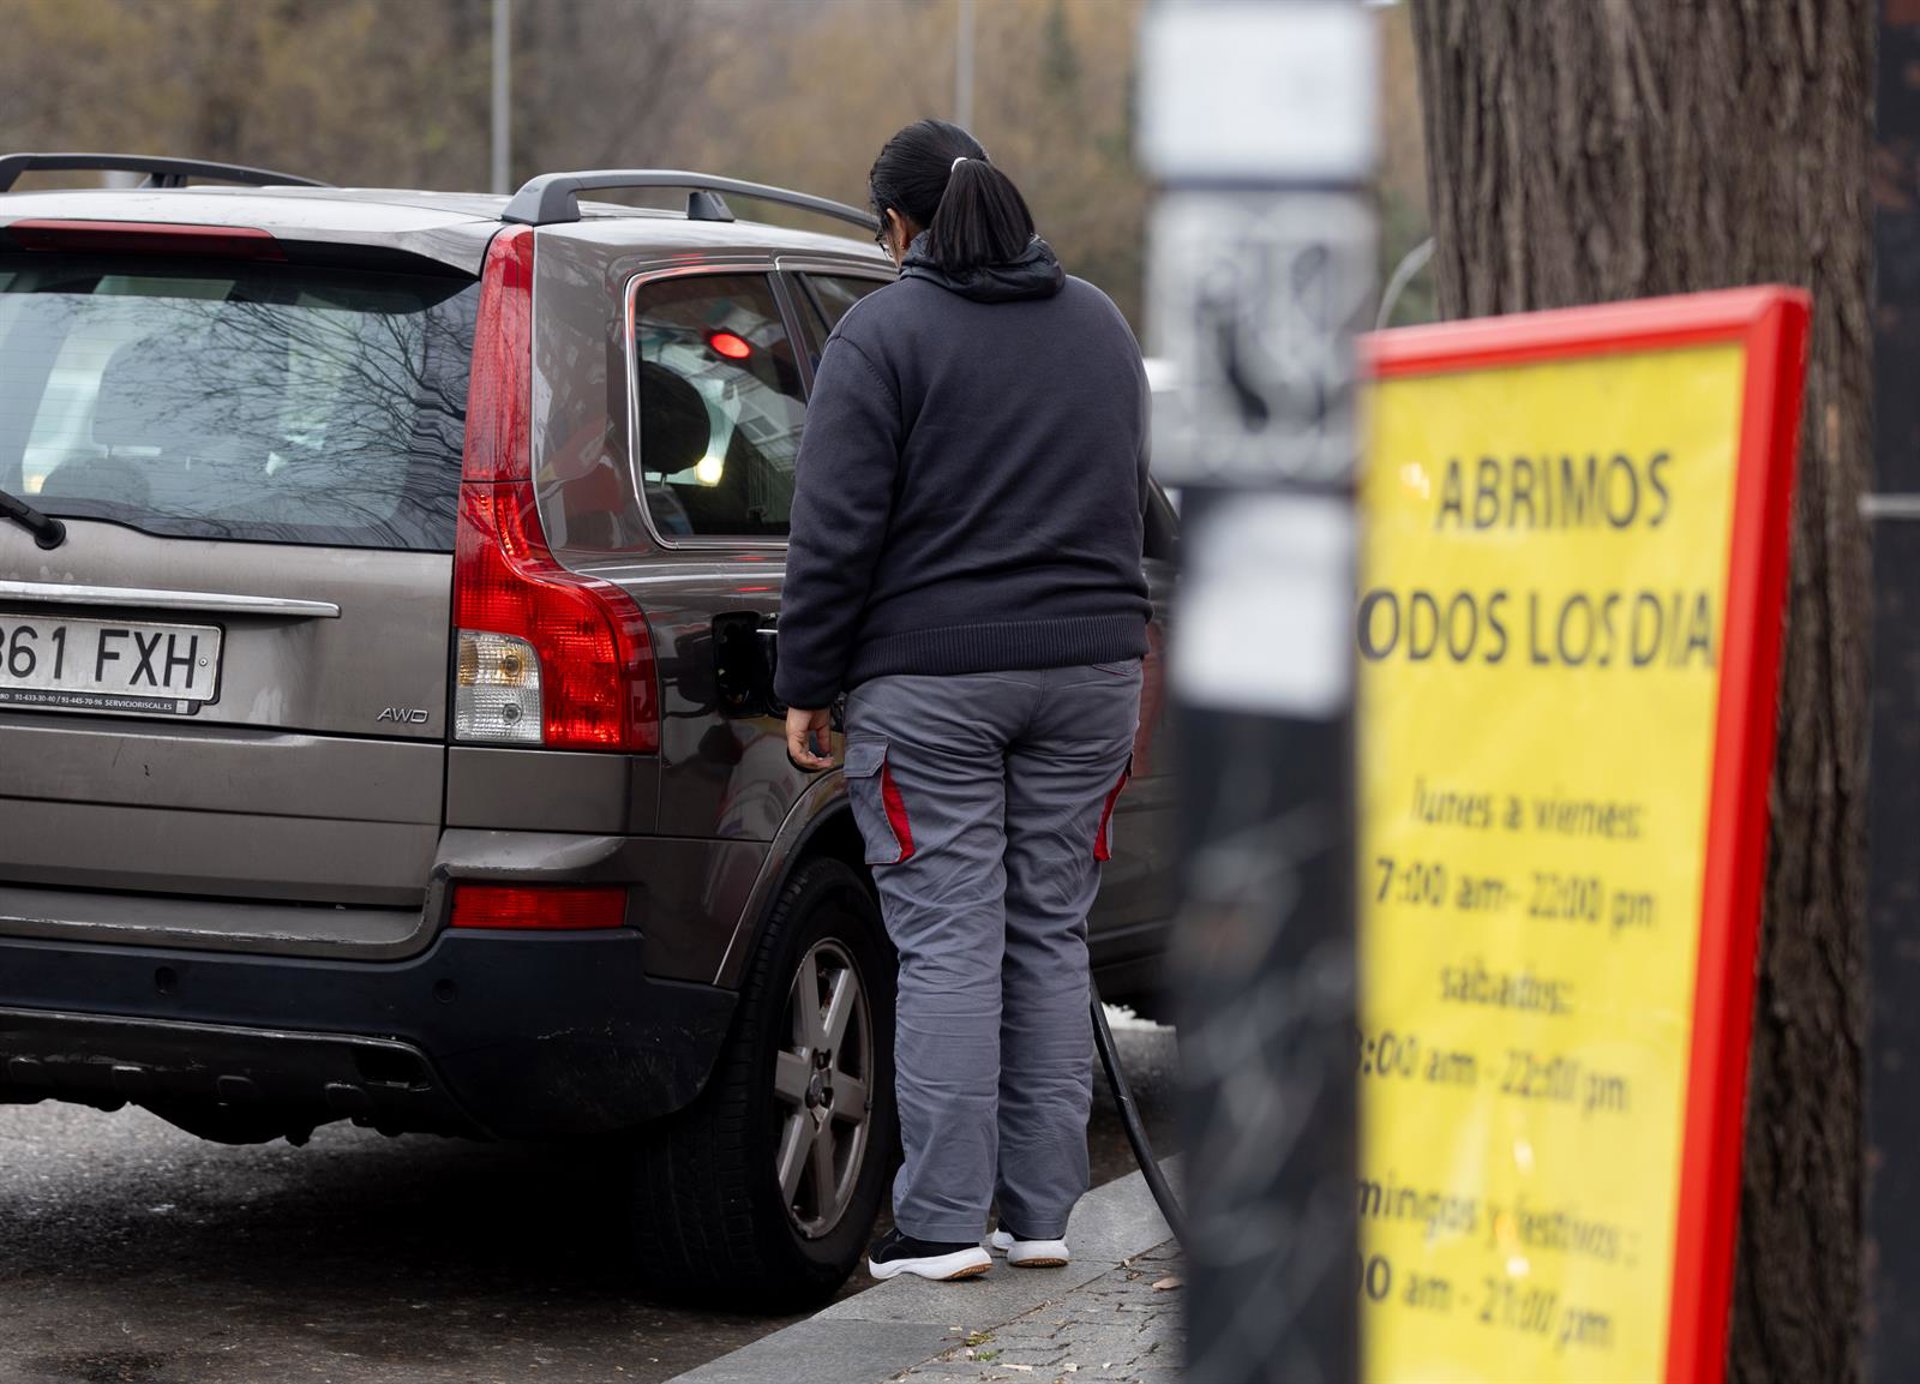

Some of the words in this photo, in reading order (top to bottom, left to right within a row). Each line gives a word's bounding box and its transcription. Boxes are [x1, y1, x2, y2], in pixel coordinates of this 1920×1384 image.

[1437, 452, 1671, 530] ABRIMOS
[0, 625, 66, 679] 61
[95, 629, 198, 688] FXH
[1355, 588, 1508, 663] ODOS
[1530, 591, 1621, 666] LOS
[104, 699, 172, 710] SERVICIORISCAL.ES
[376, 707, 428, 723] AWD
[1412, 776, 1492, 829] lunes
[1502, 795, 1522, 830] a
[1374, 857, 1448, 906] 7:00
[1528, 871, 1602, 922] 22:00
[1355, 1030, 1420, 1078] :00
[1425, 1050, 1478, 1087] am
[1501, 1048, 1580, 1103] 22:00
[1583, 1070, 1630, 1120] pm
[1357, 1167, 1477, 1254] mingos
[1404, 1271, 1451, 1312] am
[1558, 1304, 1614, 1358] pm
